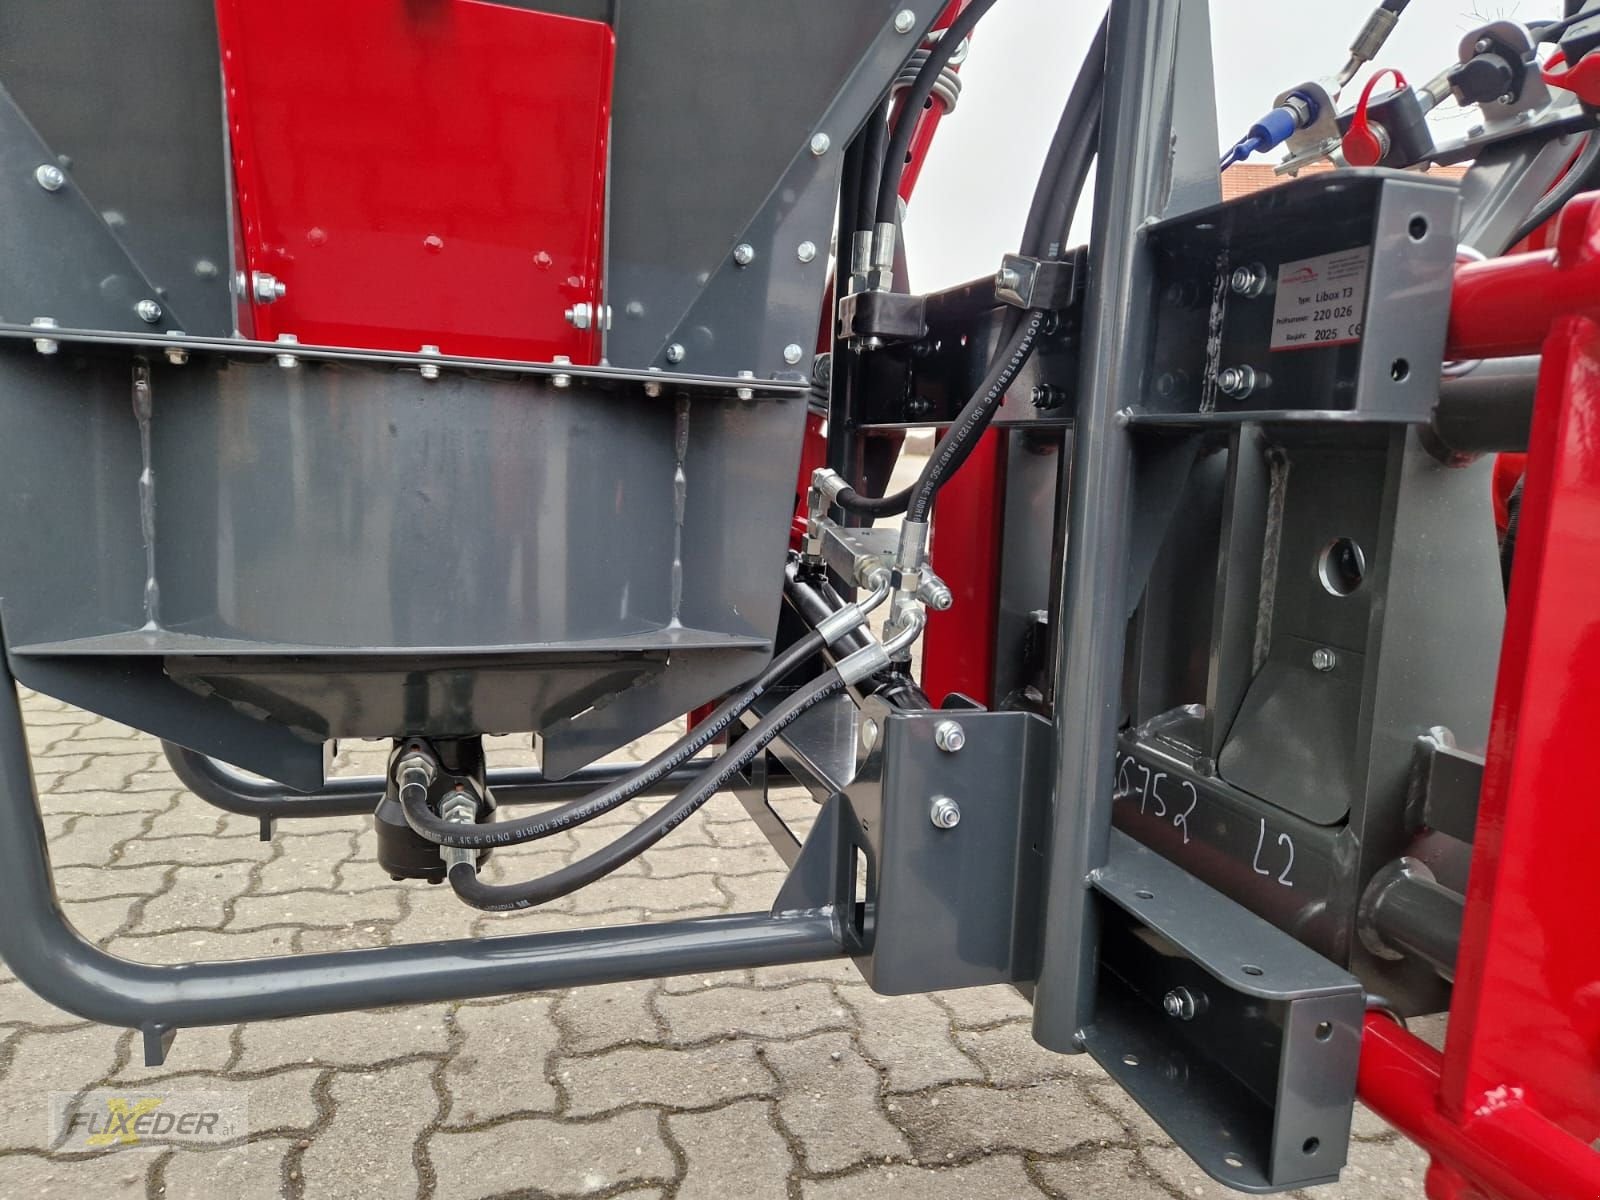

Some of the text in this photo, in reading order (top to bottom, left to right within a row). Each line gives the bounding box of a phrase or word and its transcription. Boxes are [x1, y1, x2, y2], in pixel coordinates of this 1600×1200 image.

[1315, 291, 1339, 303] Libox
[1342, 287, 1353, 298] T3
[1313, 308, 1331, 321] 220
[1333, 305, 1353, 319] 026
[1314, 328, 1338, 340] 2025
[551, 816, 570, 829] SAE
[516, 823, 550, 839] 100R16
[1253, 818, 1295, 887] L2
